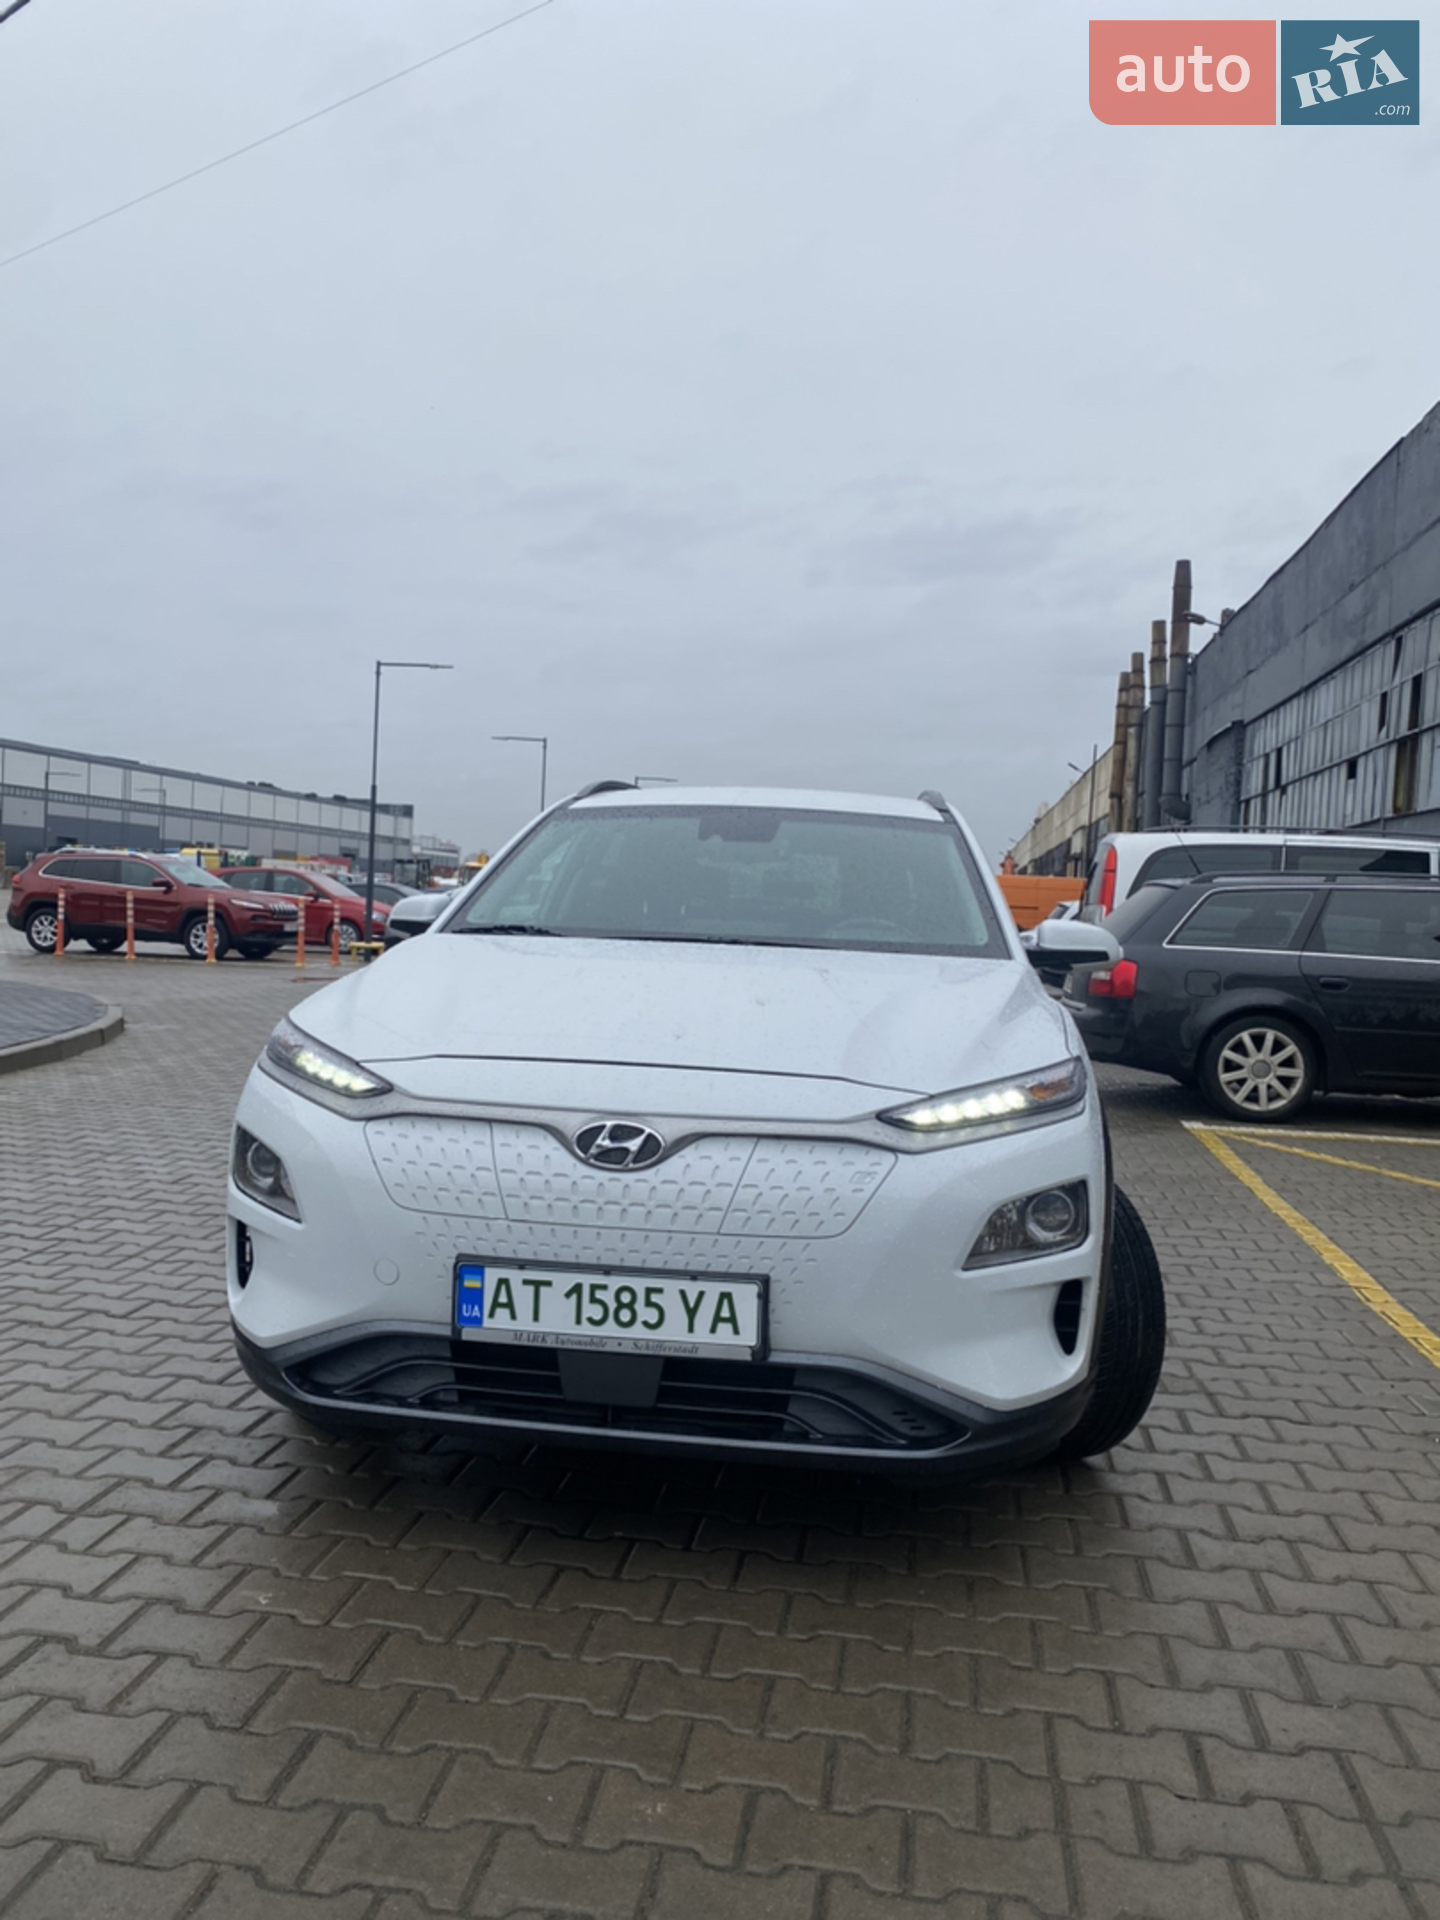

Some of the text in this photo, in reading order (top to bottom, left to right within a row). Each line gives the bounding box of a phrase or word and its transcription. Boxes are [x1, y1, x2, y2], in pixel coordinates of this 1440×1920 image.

[462, 1303, 481, 1318] UA
[488, 1277, 741, 1336] AT 1585 YA
[511, 1332, 550, 1345] MARK
